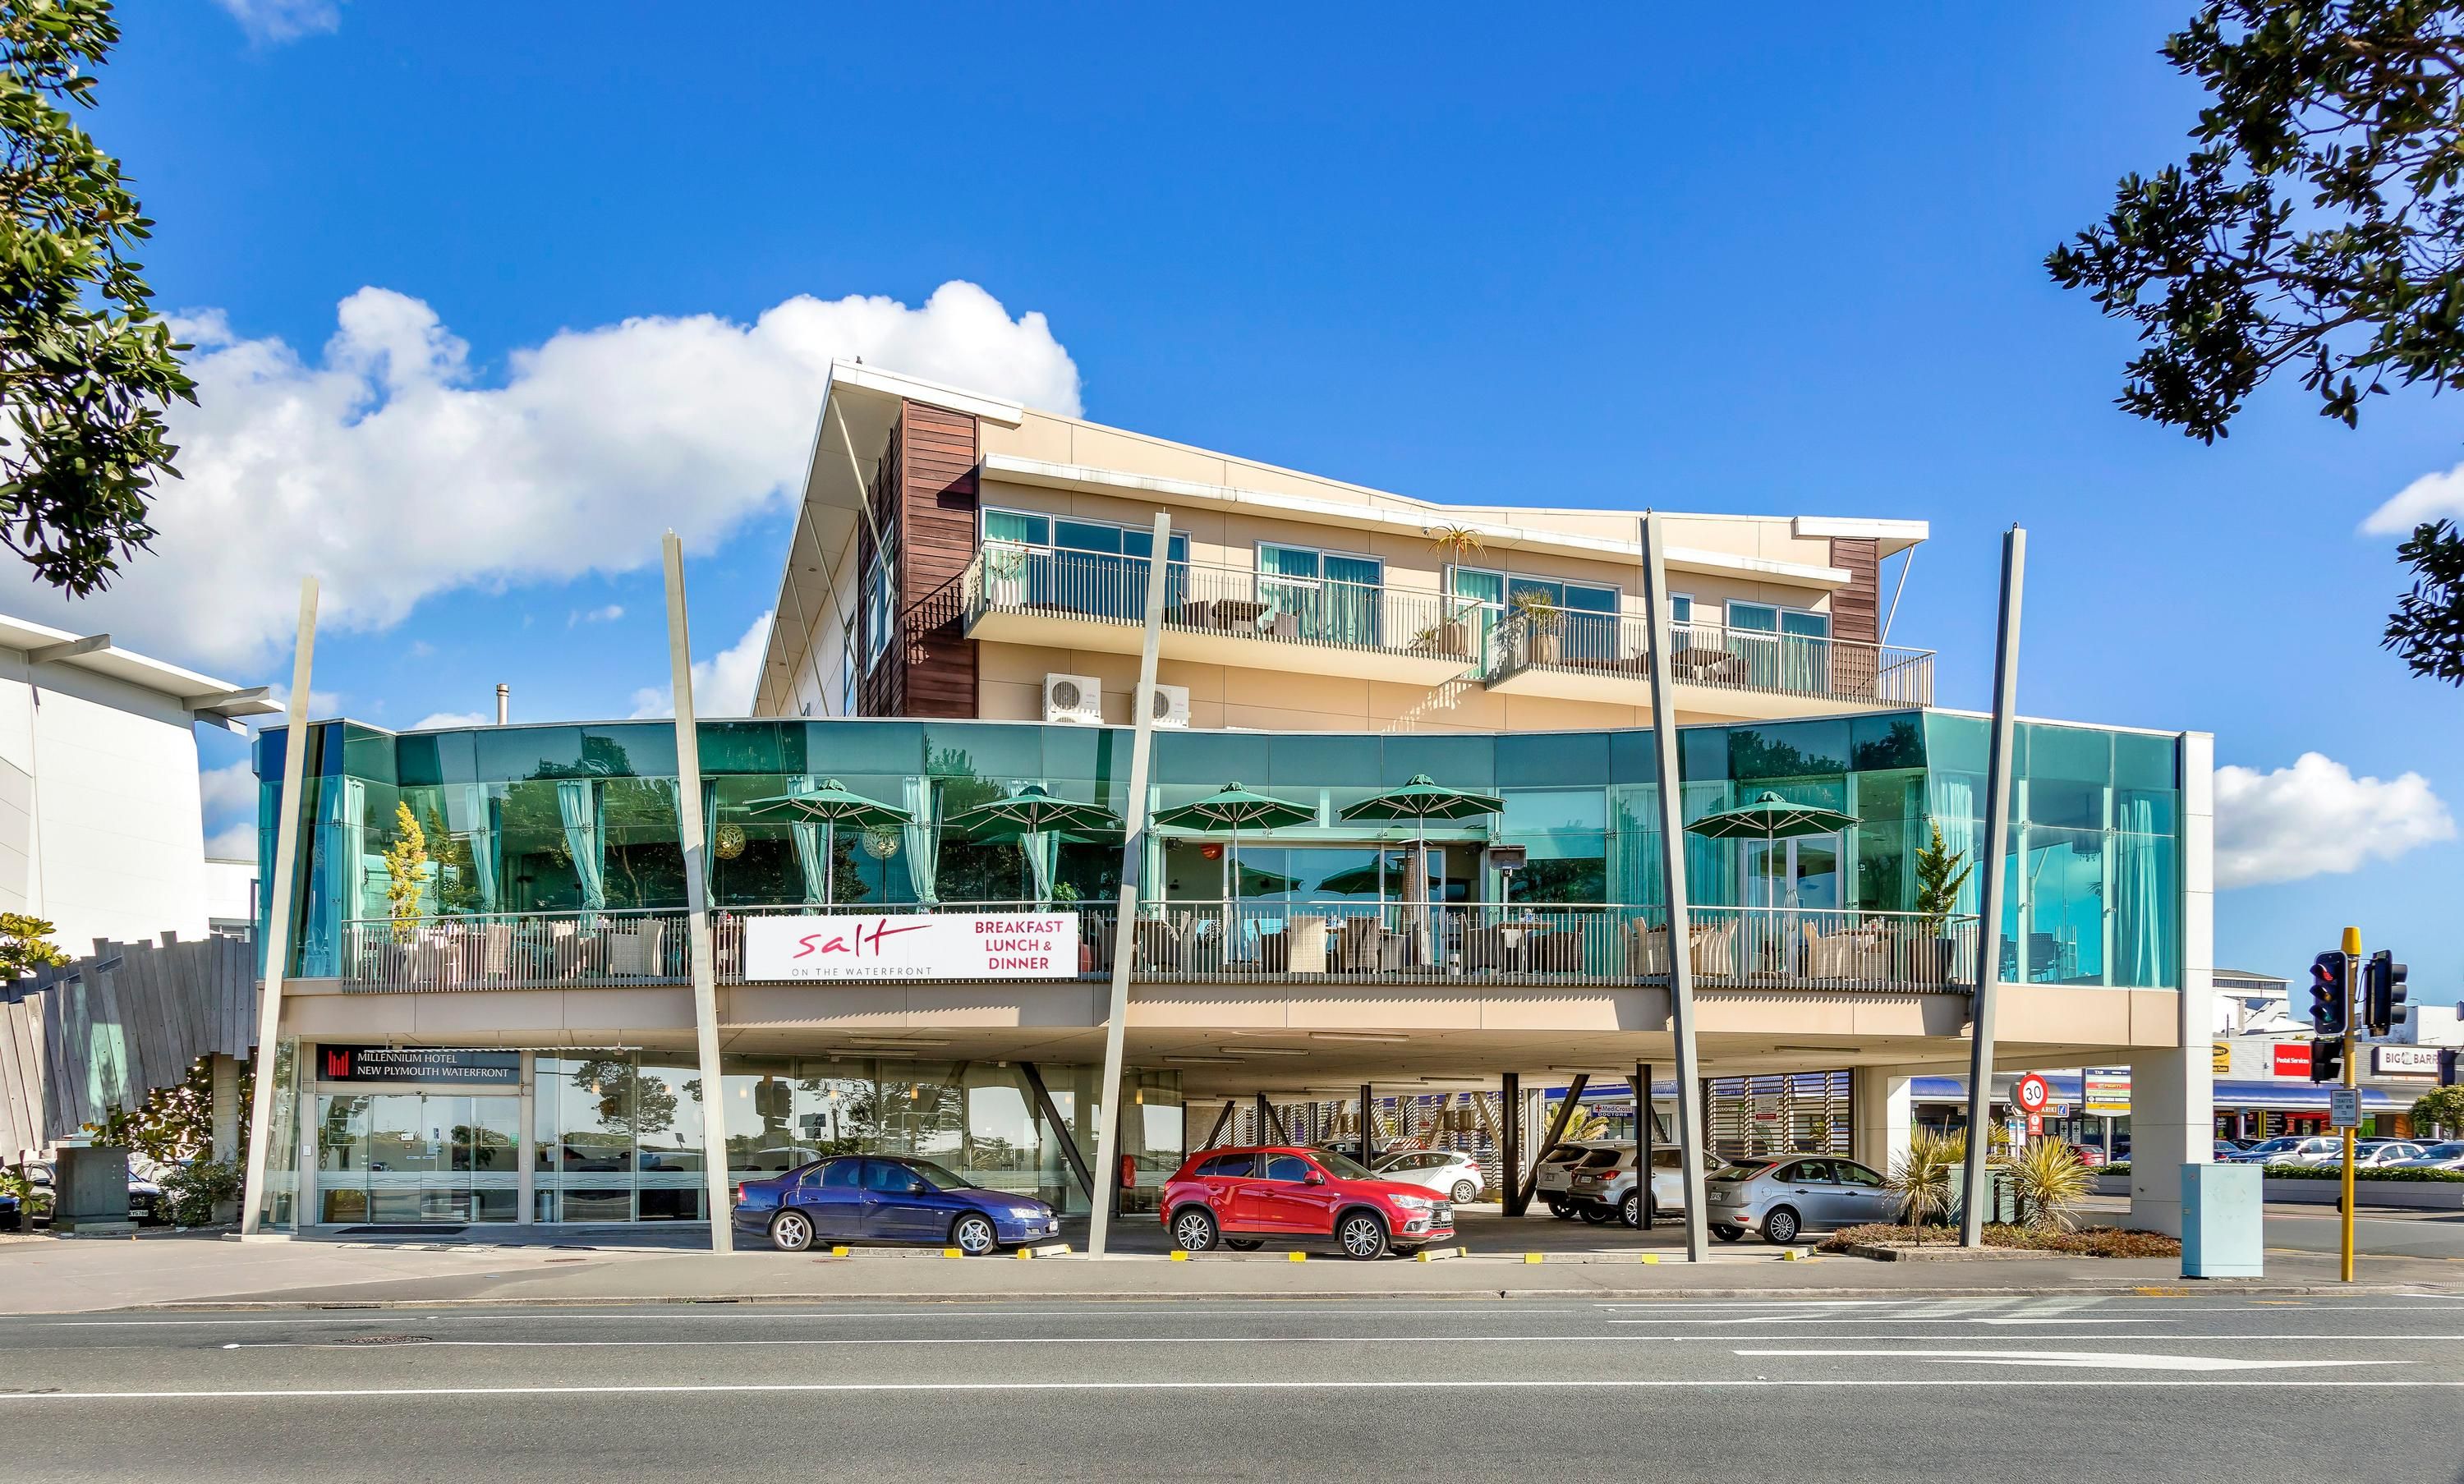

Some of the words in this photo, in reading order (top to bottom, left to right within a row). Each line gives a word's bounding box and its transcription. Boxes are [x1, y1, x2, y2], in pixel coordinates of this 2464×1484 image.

[975, 921, 1064, 933] BREAKFAST
[793, 918, 933, 958] salt
[986, 939, 1038, 951] LUNCH
[1043, 941, 1051, 951] &
[989, 957, 1049, 969] DINNER
[792, 968, 808, 976] ON
[816, 967, 838, 976] THE
[845, 967, 932, 976] WATERFRONT
[357, 1052, 421, 1063] MILLENNIUM
[424, 1054, 457, 1064] HOTEL
[2386, 1053, 2400, 1063] BIG
[357, 1066, 381, 1075] NEW
[384, 1066, 439, 1076] PLYMOUTH
[442, 1068, 508, 1077] WATERFRONT
[2025, 1086, 2041, 1100] 30
